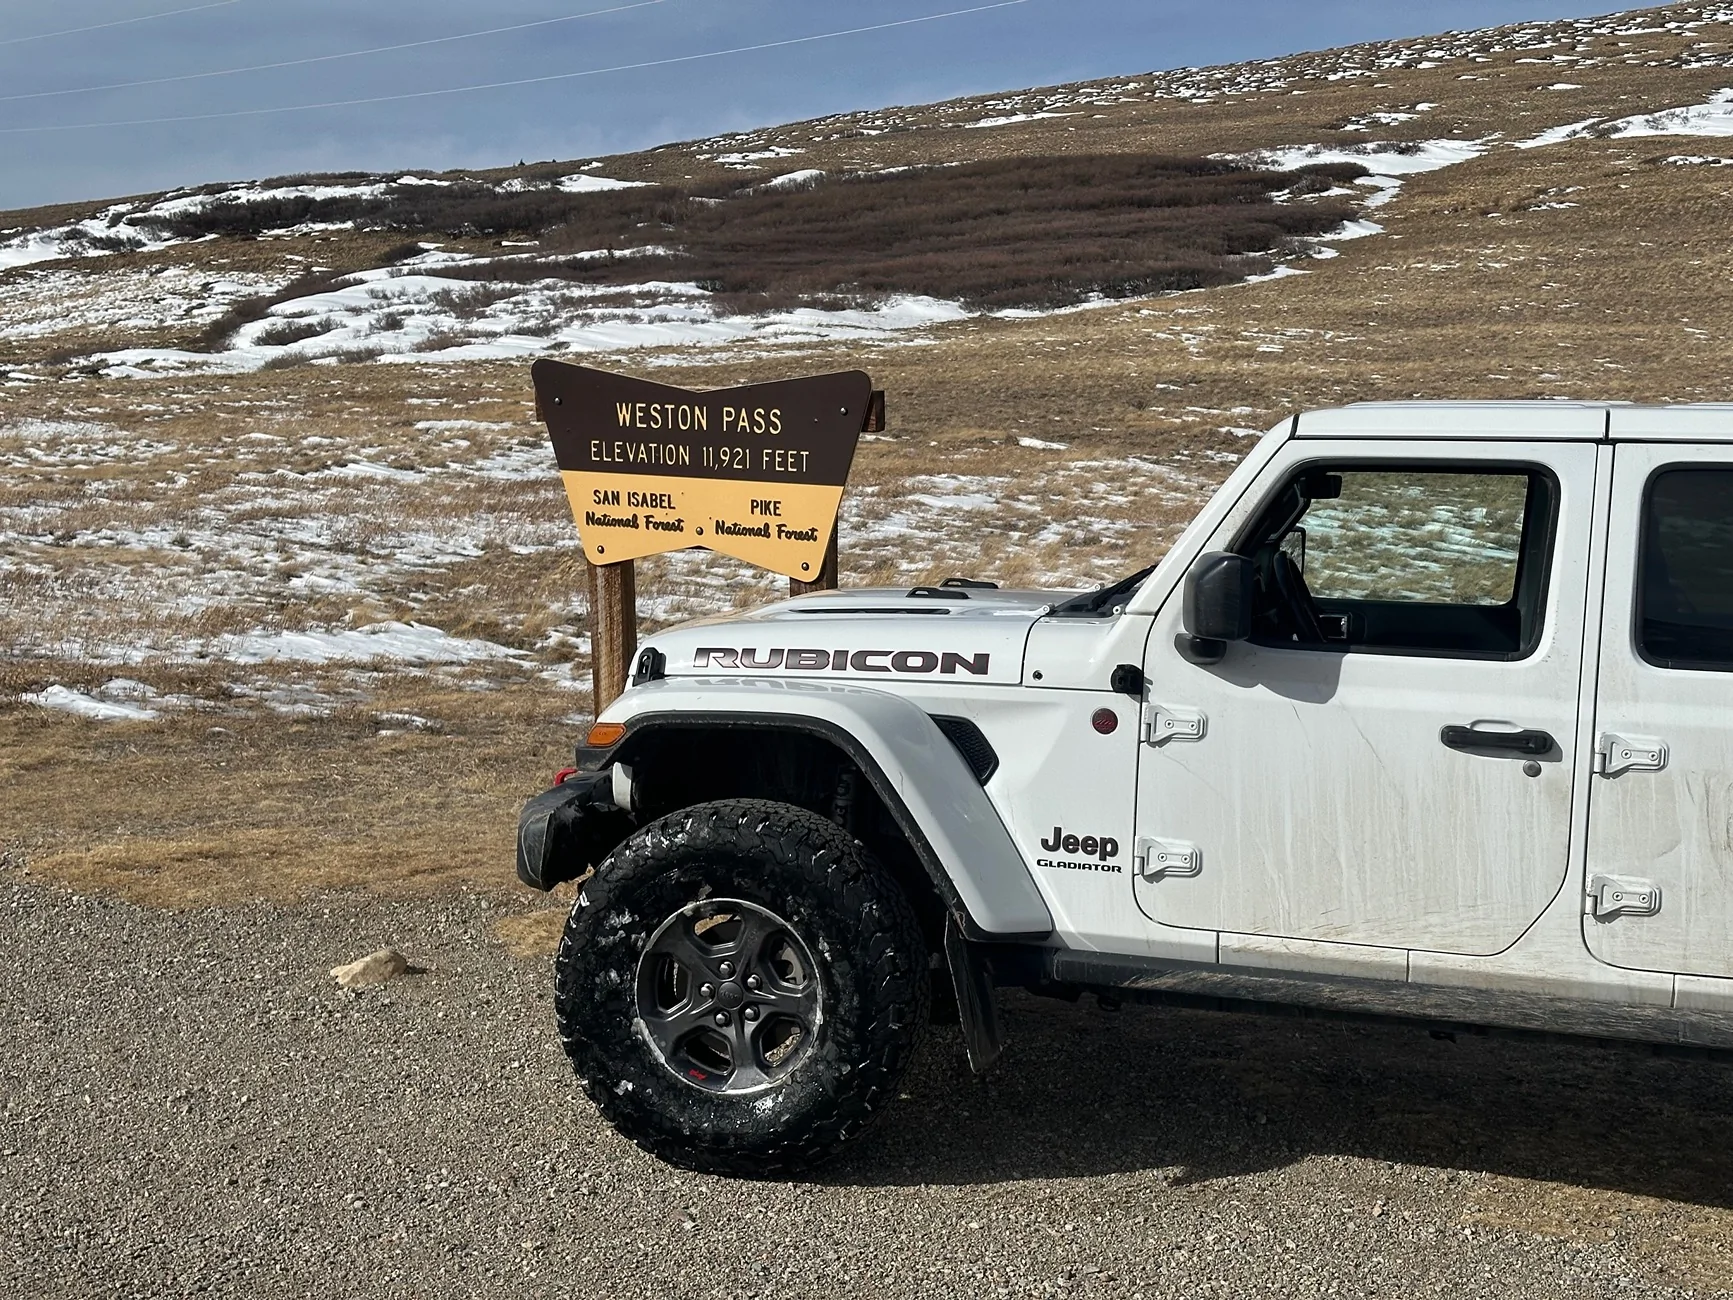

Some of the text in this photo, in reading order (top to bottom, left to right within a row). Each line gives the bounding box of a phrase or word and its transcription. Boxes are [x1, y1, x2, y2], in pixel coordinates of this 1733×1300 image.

[616, 402, 782, 435] WESTON PASS
[590, 440, 810, 473] ELEVATION 11,921 FEET
[592, 489, 677, 510] SAN ISABEL
[750, 499, 782, 517] PIKE
[585, 511, 685, 533] National Forest
[715, 519, 819, 543] National Forest
[693, 647, 991, 676] RUBICON
[1040, 826, 1119, 862] Jeep
[1036, 858, 1122, 873] GLADIATOR
